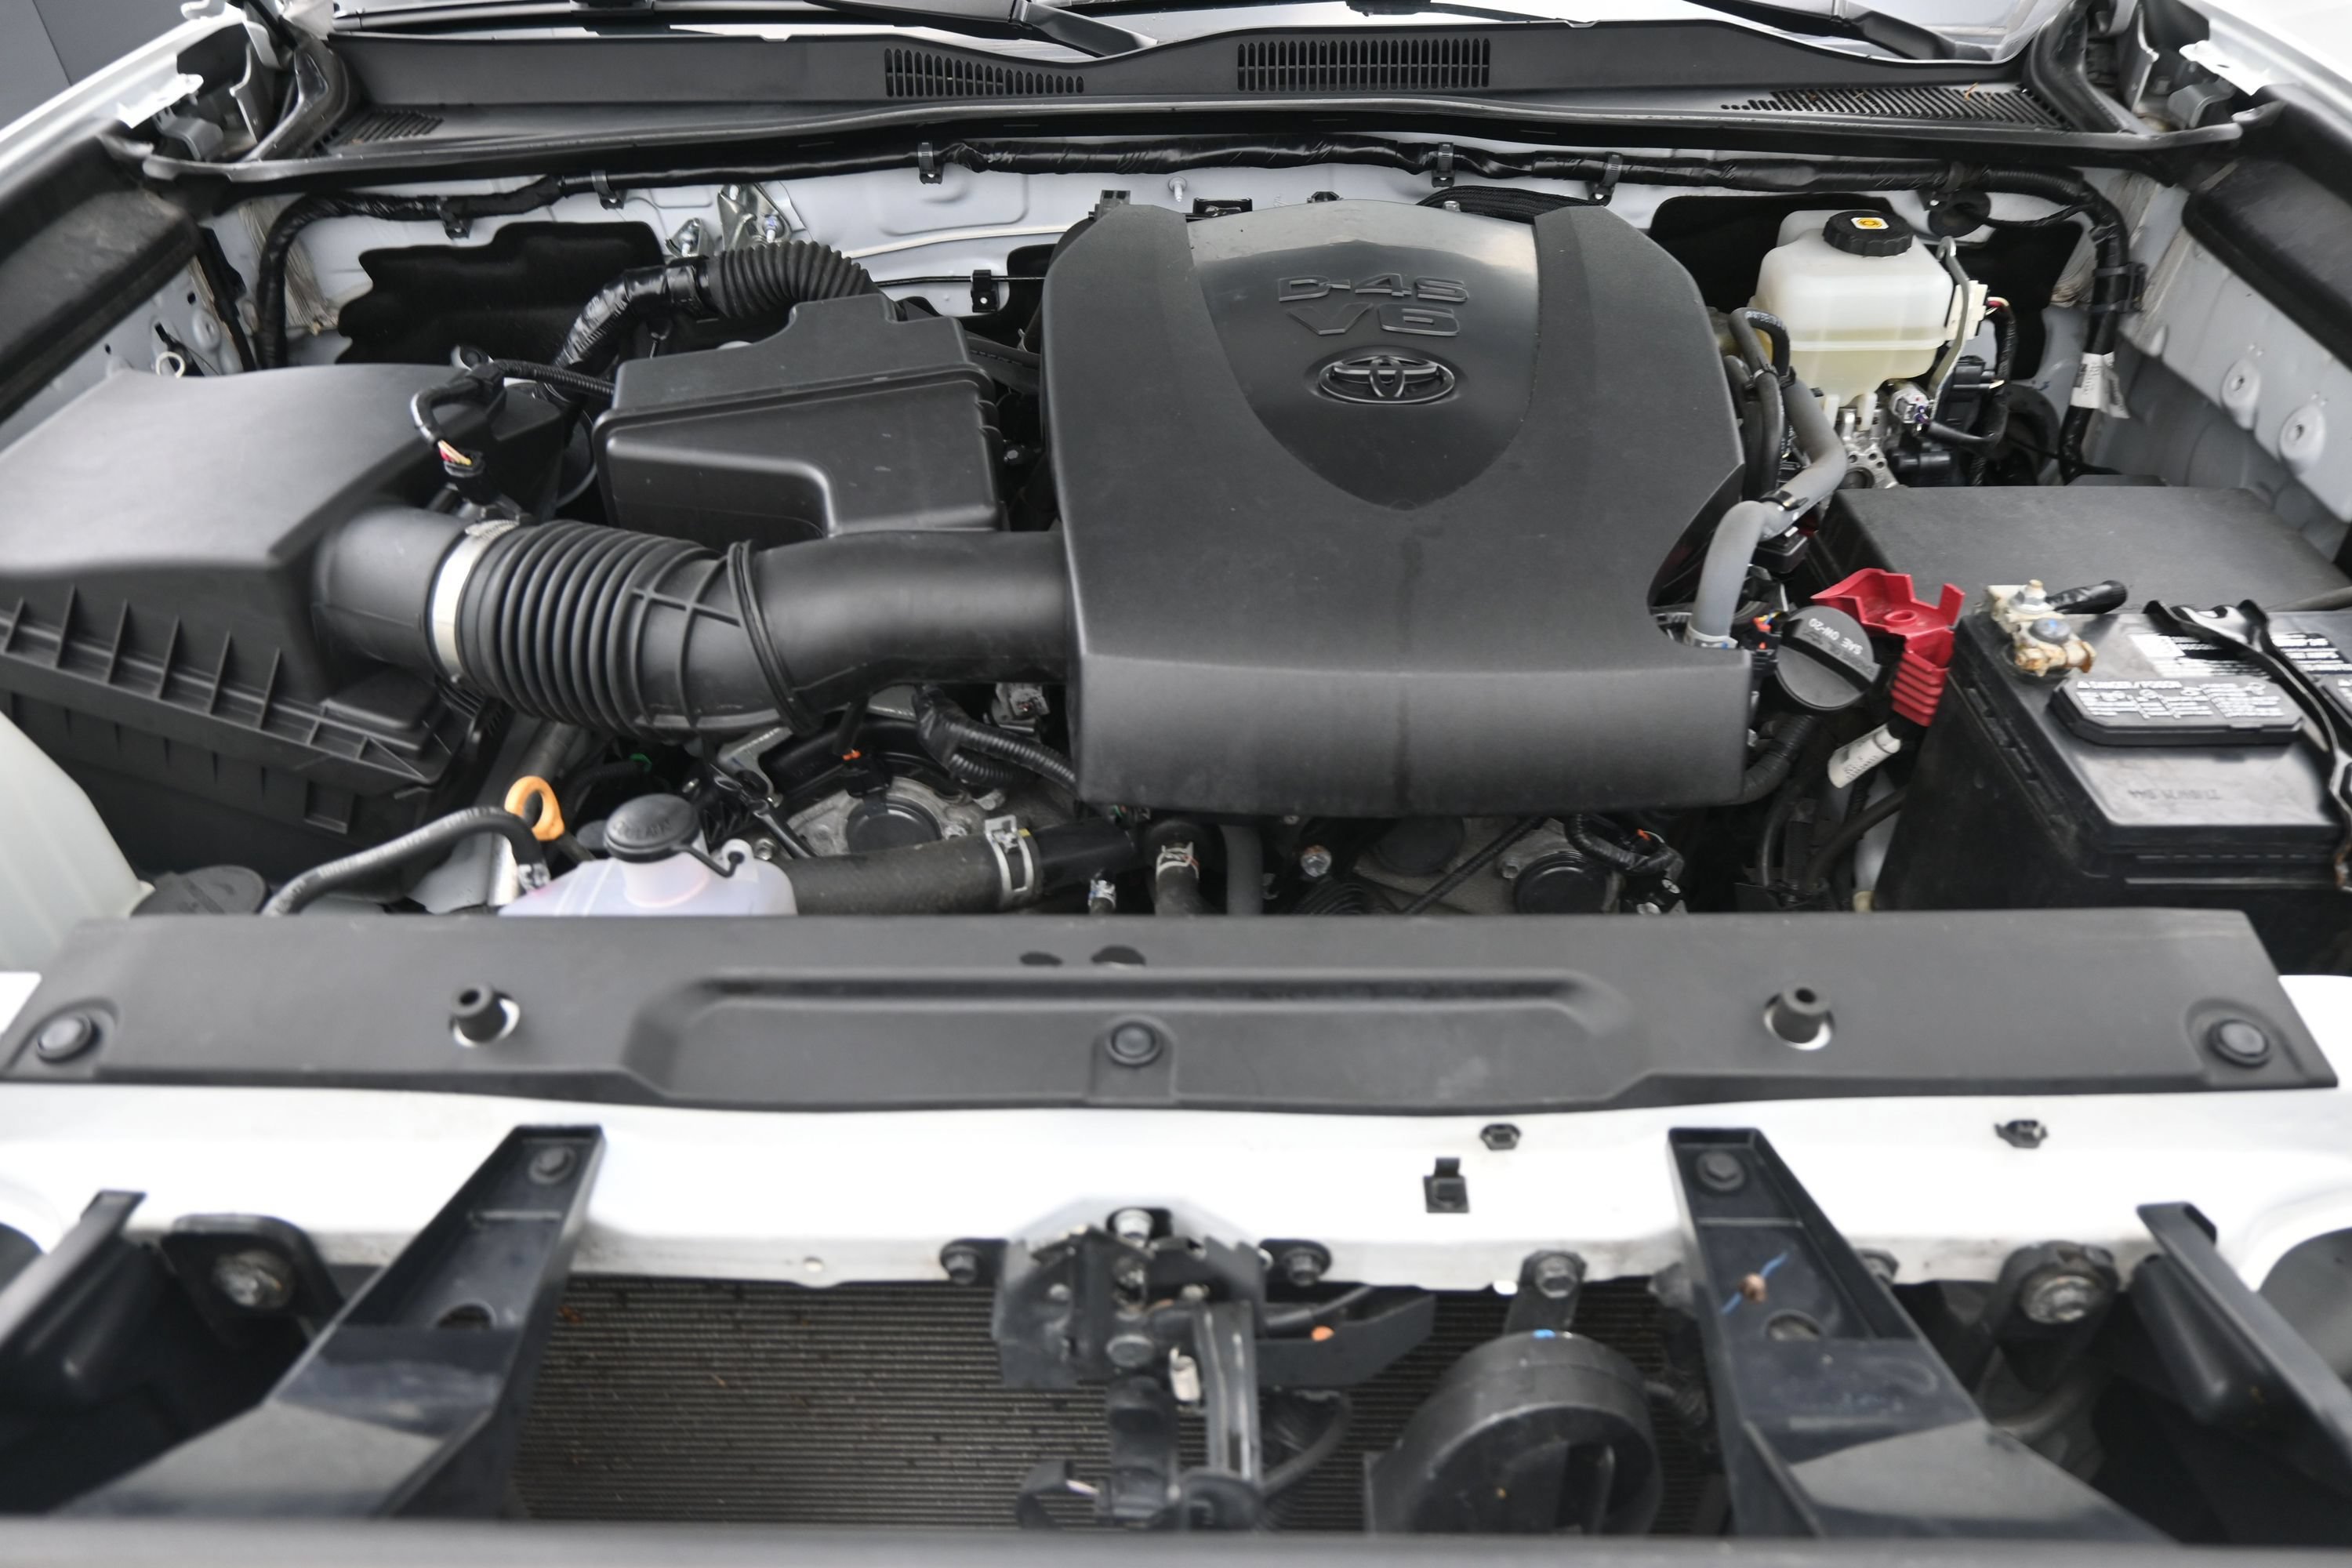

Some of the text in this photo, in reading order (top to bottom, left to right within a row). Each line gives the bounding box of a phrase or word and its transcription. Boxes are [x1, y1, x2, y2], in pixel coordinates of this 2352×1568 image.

[1278, 273, 1470, 303] D-4S
[1286, 301, 1461, 336] V6
[1808, 618, 1840, 641] 0W-20
[1841, 637, 1863, 655] SAE
